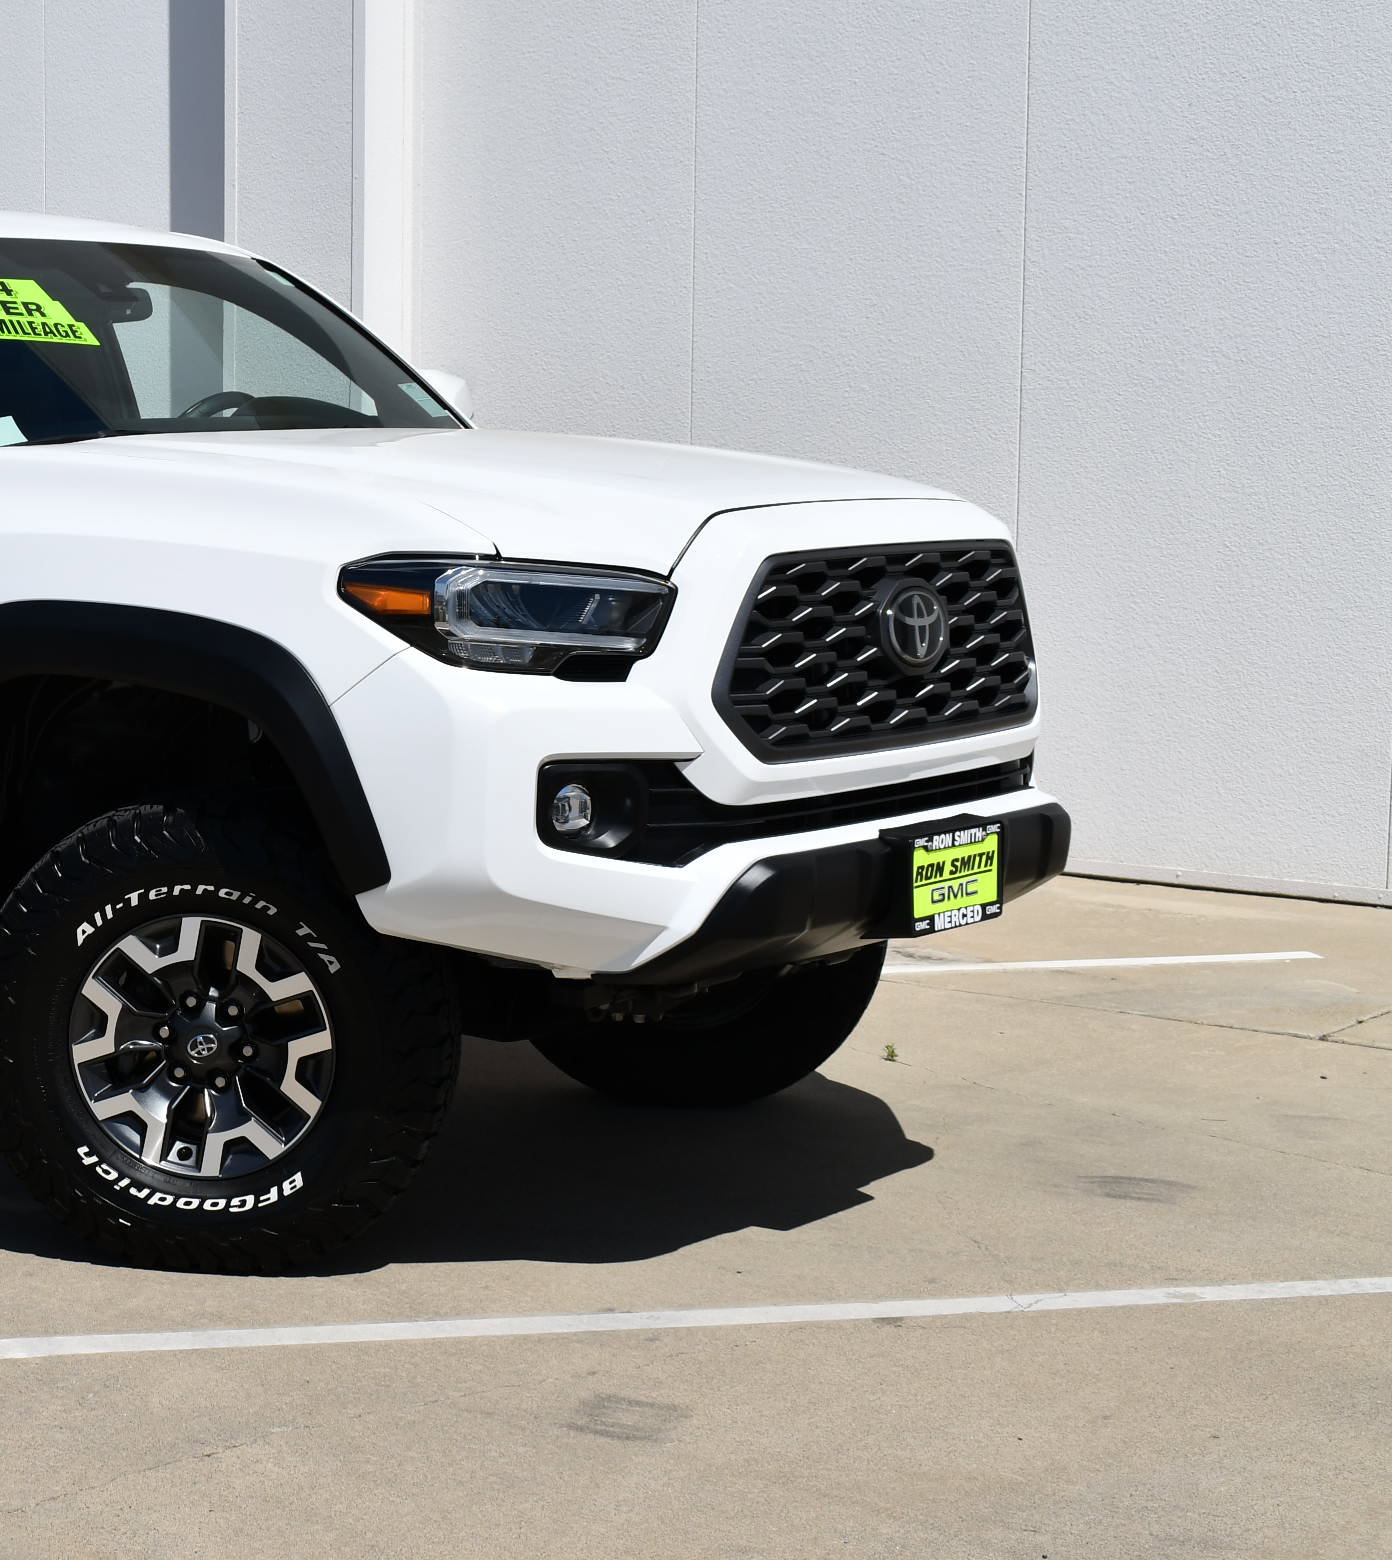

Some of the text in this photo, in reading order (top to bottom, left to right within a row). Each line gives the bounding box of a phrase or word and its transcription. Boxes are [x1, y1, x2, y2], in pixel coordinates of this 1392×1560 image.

[932, 827, 983, 850] RON SMITH
[986, 823, 1001, 834] GMC
[914, 850, 996, 884] RON SMITH
[930, 878, 979, 905] GMC
[934, 904, 983, 932] MERCED
[986, 903, 1001, 915] GMC
[75, 883, 342, 976] All-Terrain T/A
[914, 919, 931, 931] GMC
[75, 1144, 305, 1214] BFGoodrich
